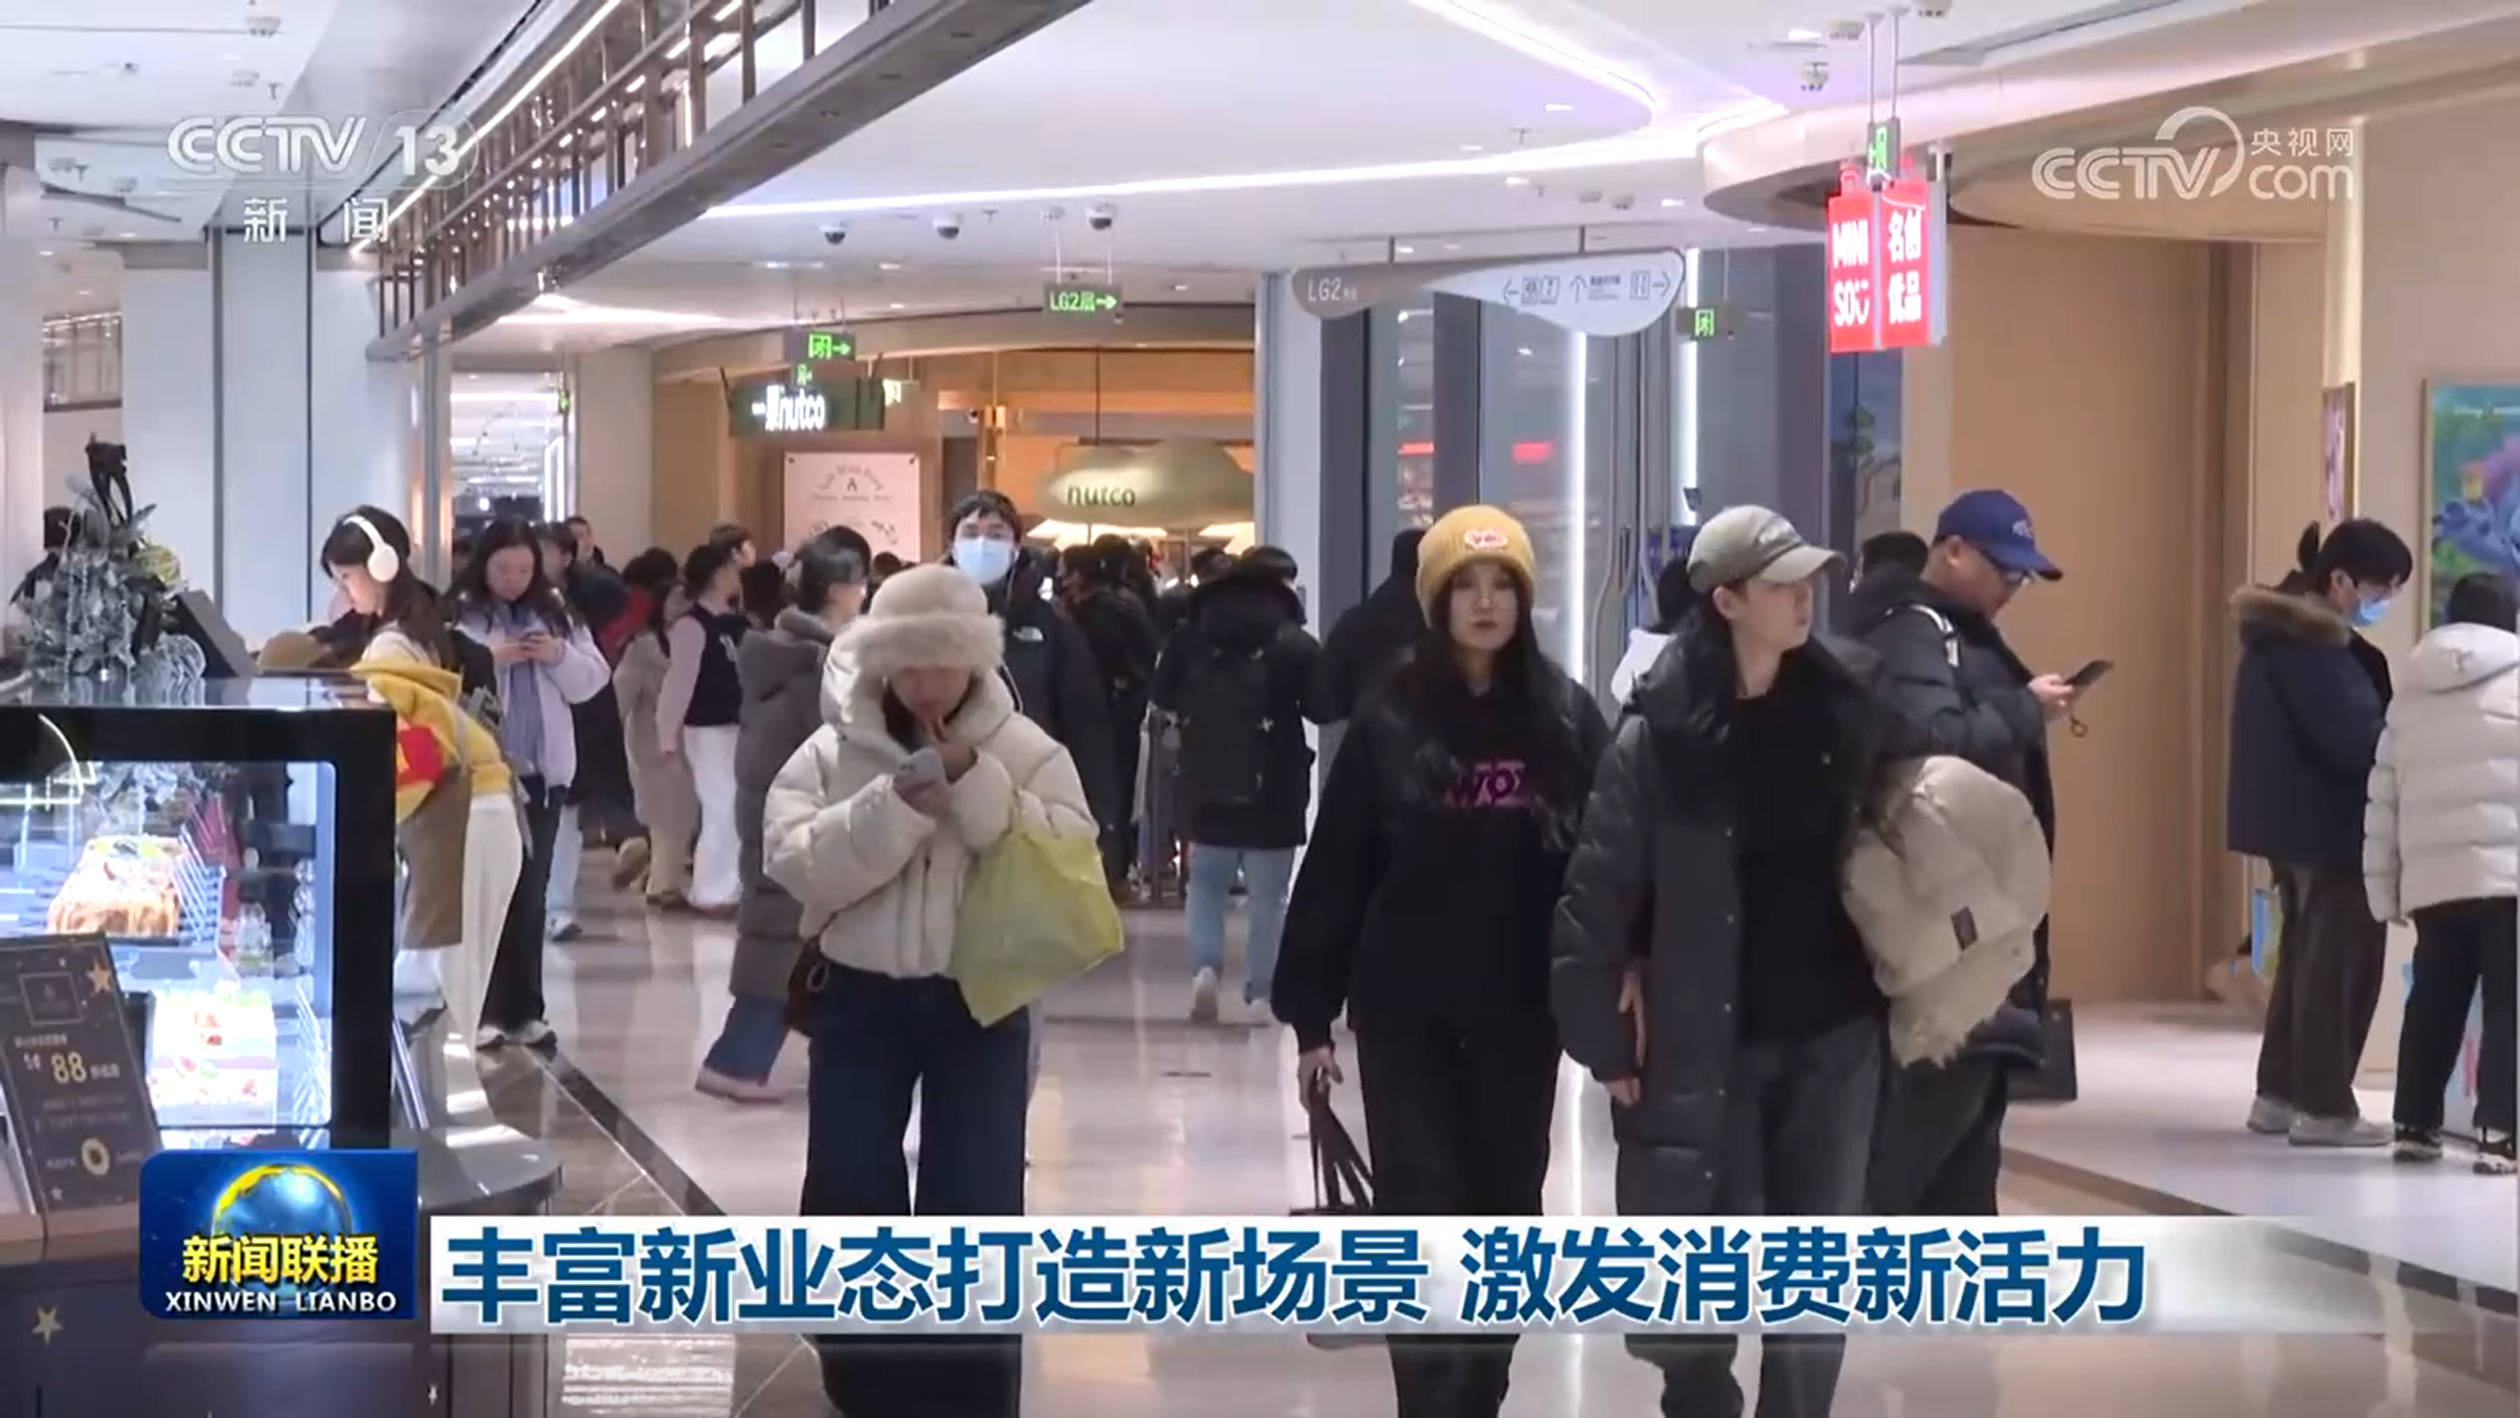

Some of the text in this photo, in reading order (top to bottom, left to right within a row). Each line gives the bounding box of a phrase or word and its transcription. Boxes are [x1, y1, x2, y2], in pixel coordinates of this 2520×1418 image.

[1832, 219, 1869, 268] MINI
[1888, 208, 1922, 263] 名创
[1308, 277, 1341, 302] LG2
[1888, 271, 1922, 324] 优品
[1067, 486, 1135, 507] nutco
[51, 1051, 87, 1083] 88
